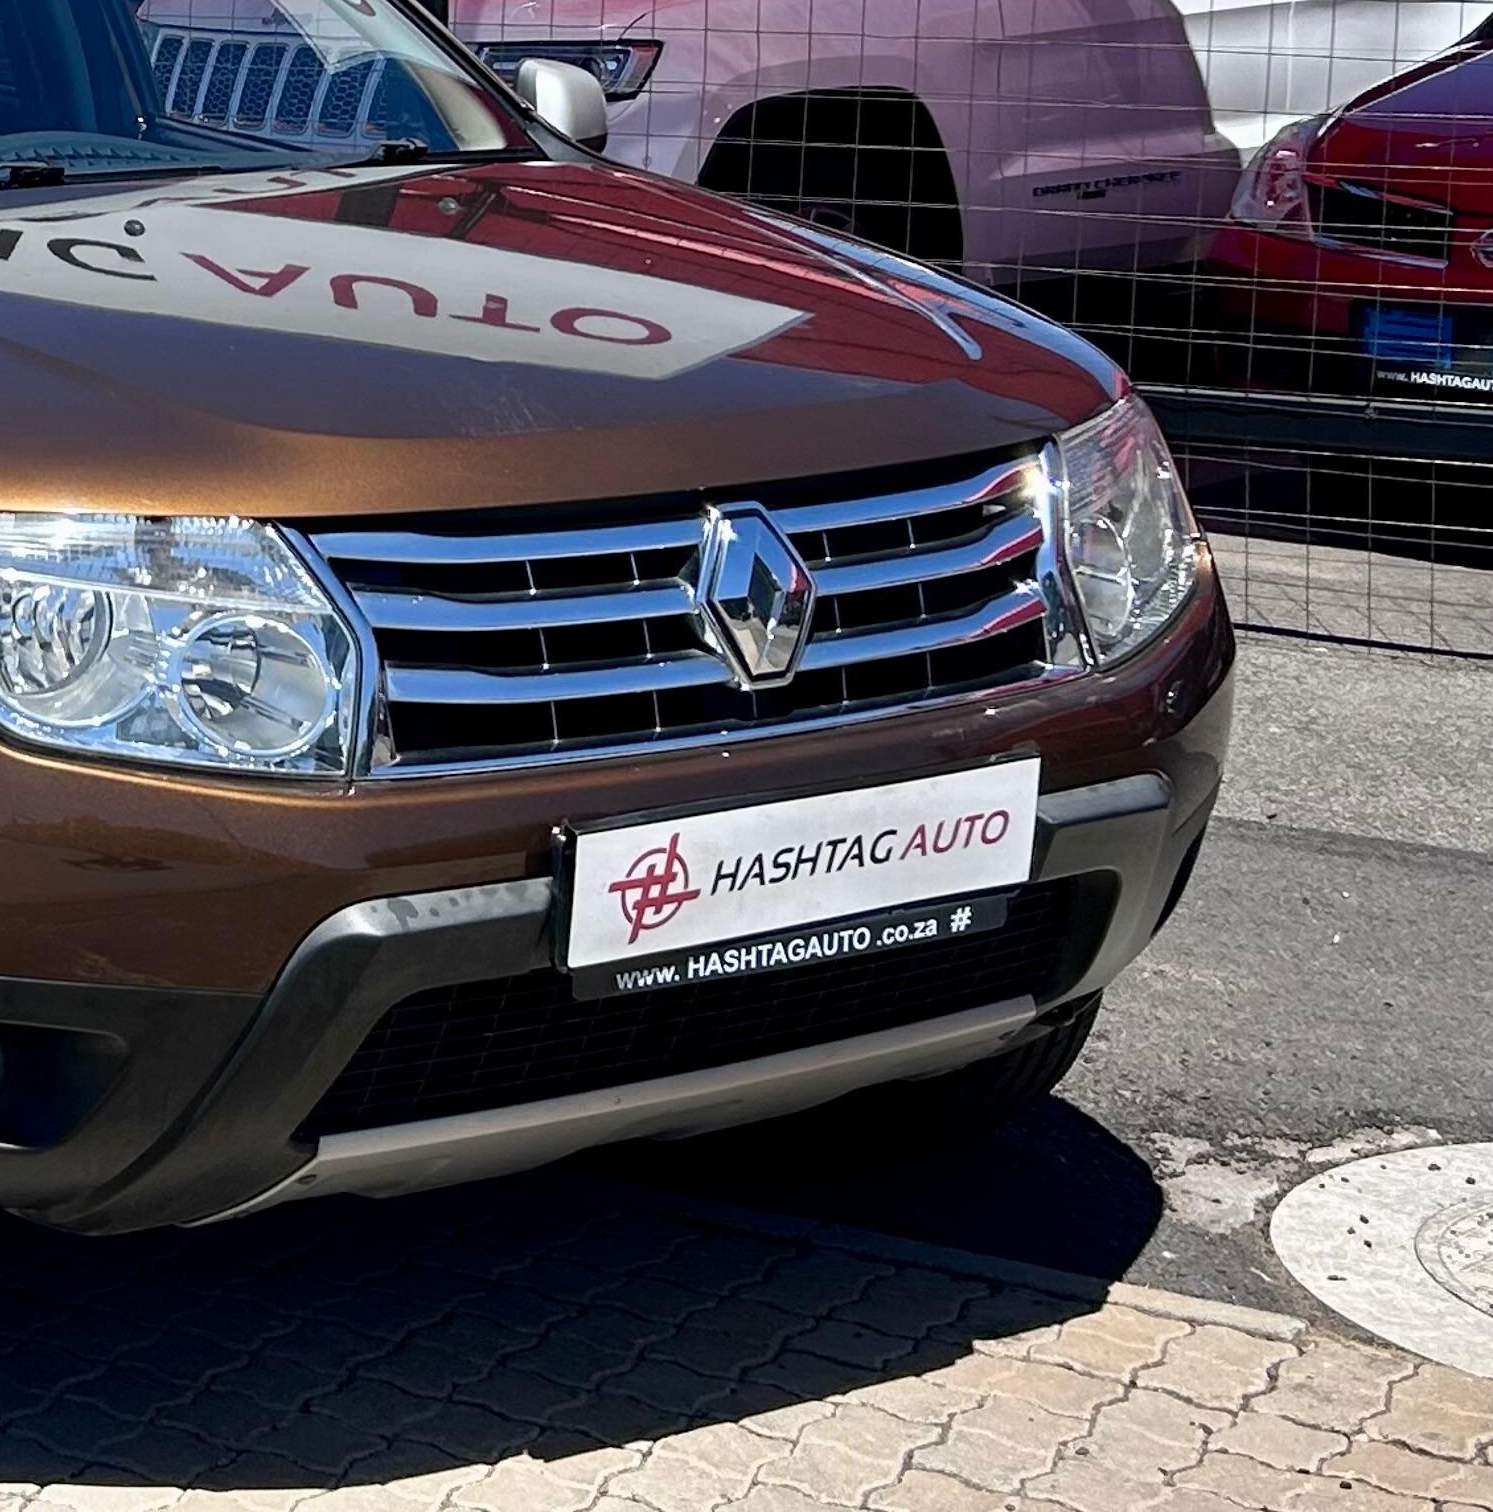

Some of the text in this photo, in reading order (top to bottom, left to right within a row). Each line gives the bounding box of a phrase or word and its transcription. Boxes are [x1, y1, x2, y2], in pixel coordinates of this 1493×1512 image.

[710, 809, 1010, 896] HASHTAG AUTO
[616, 962, 681, 990] www.
[687, 925, 871, 979] HASHTAGAUTO
